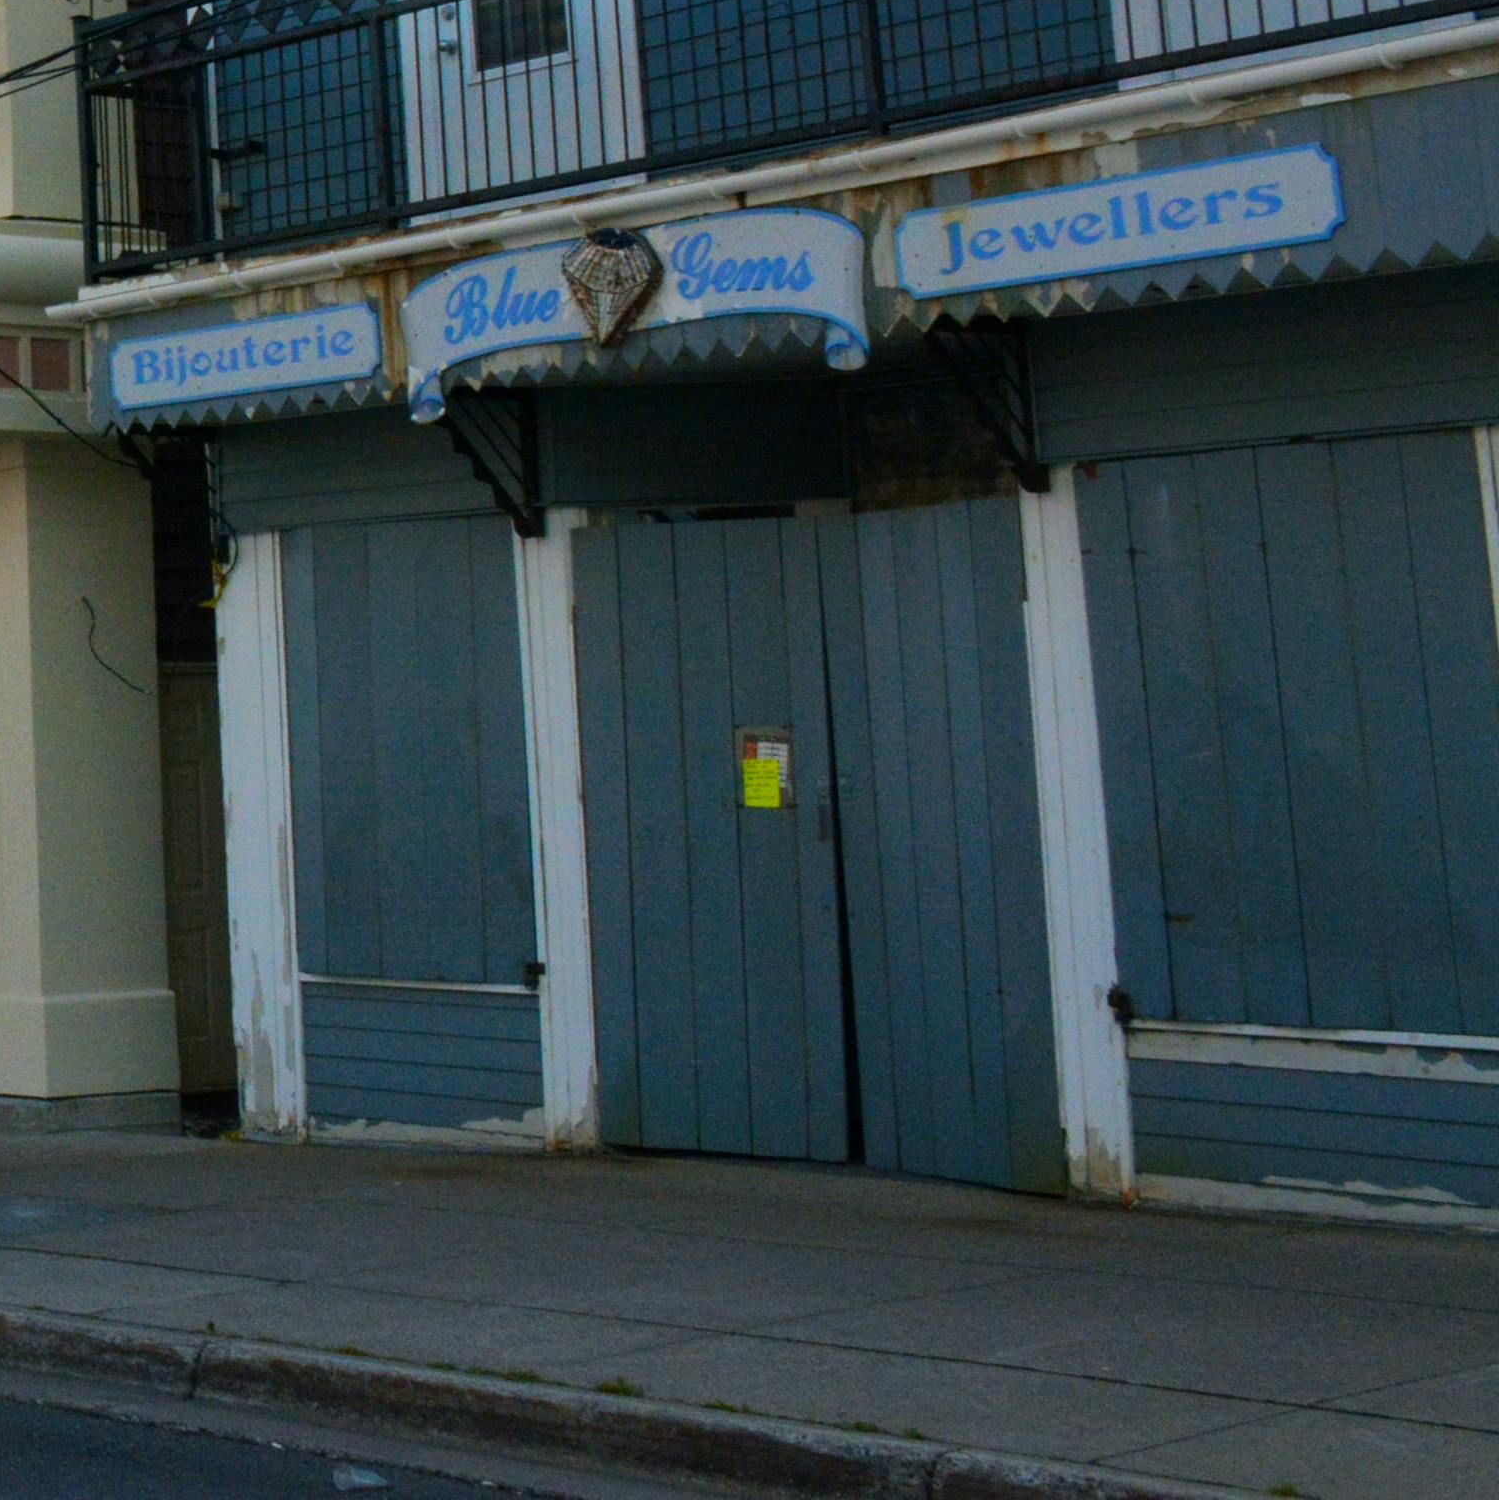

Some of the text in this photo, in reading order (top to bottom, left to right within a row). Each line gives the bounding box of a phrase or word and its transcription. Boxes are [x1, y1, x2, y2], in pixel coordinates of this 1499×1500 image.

[939, 181, 1284, 276] Jewellers
[443, 230, 816, 345] Blue Gems
[131, 323, 355, 388] Bijouterie
